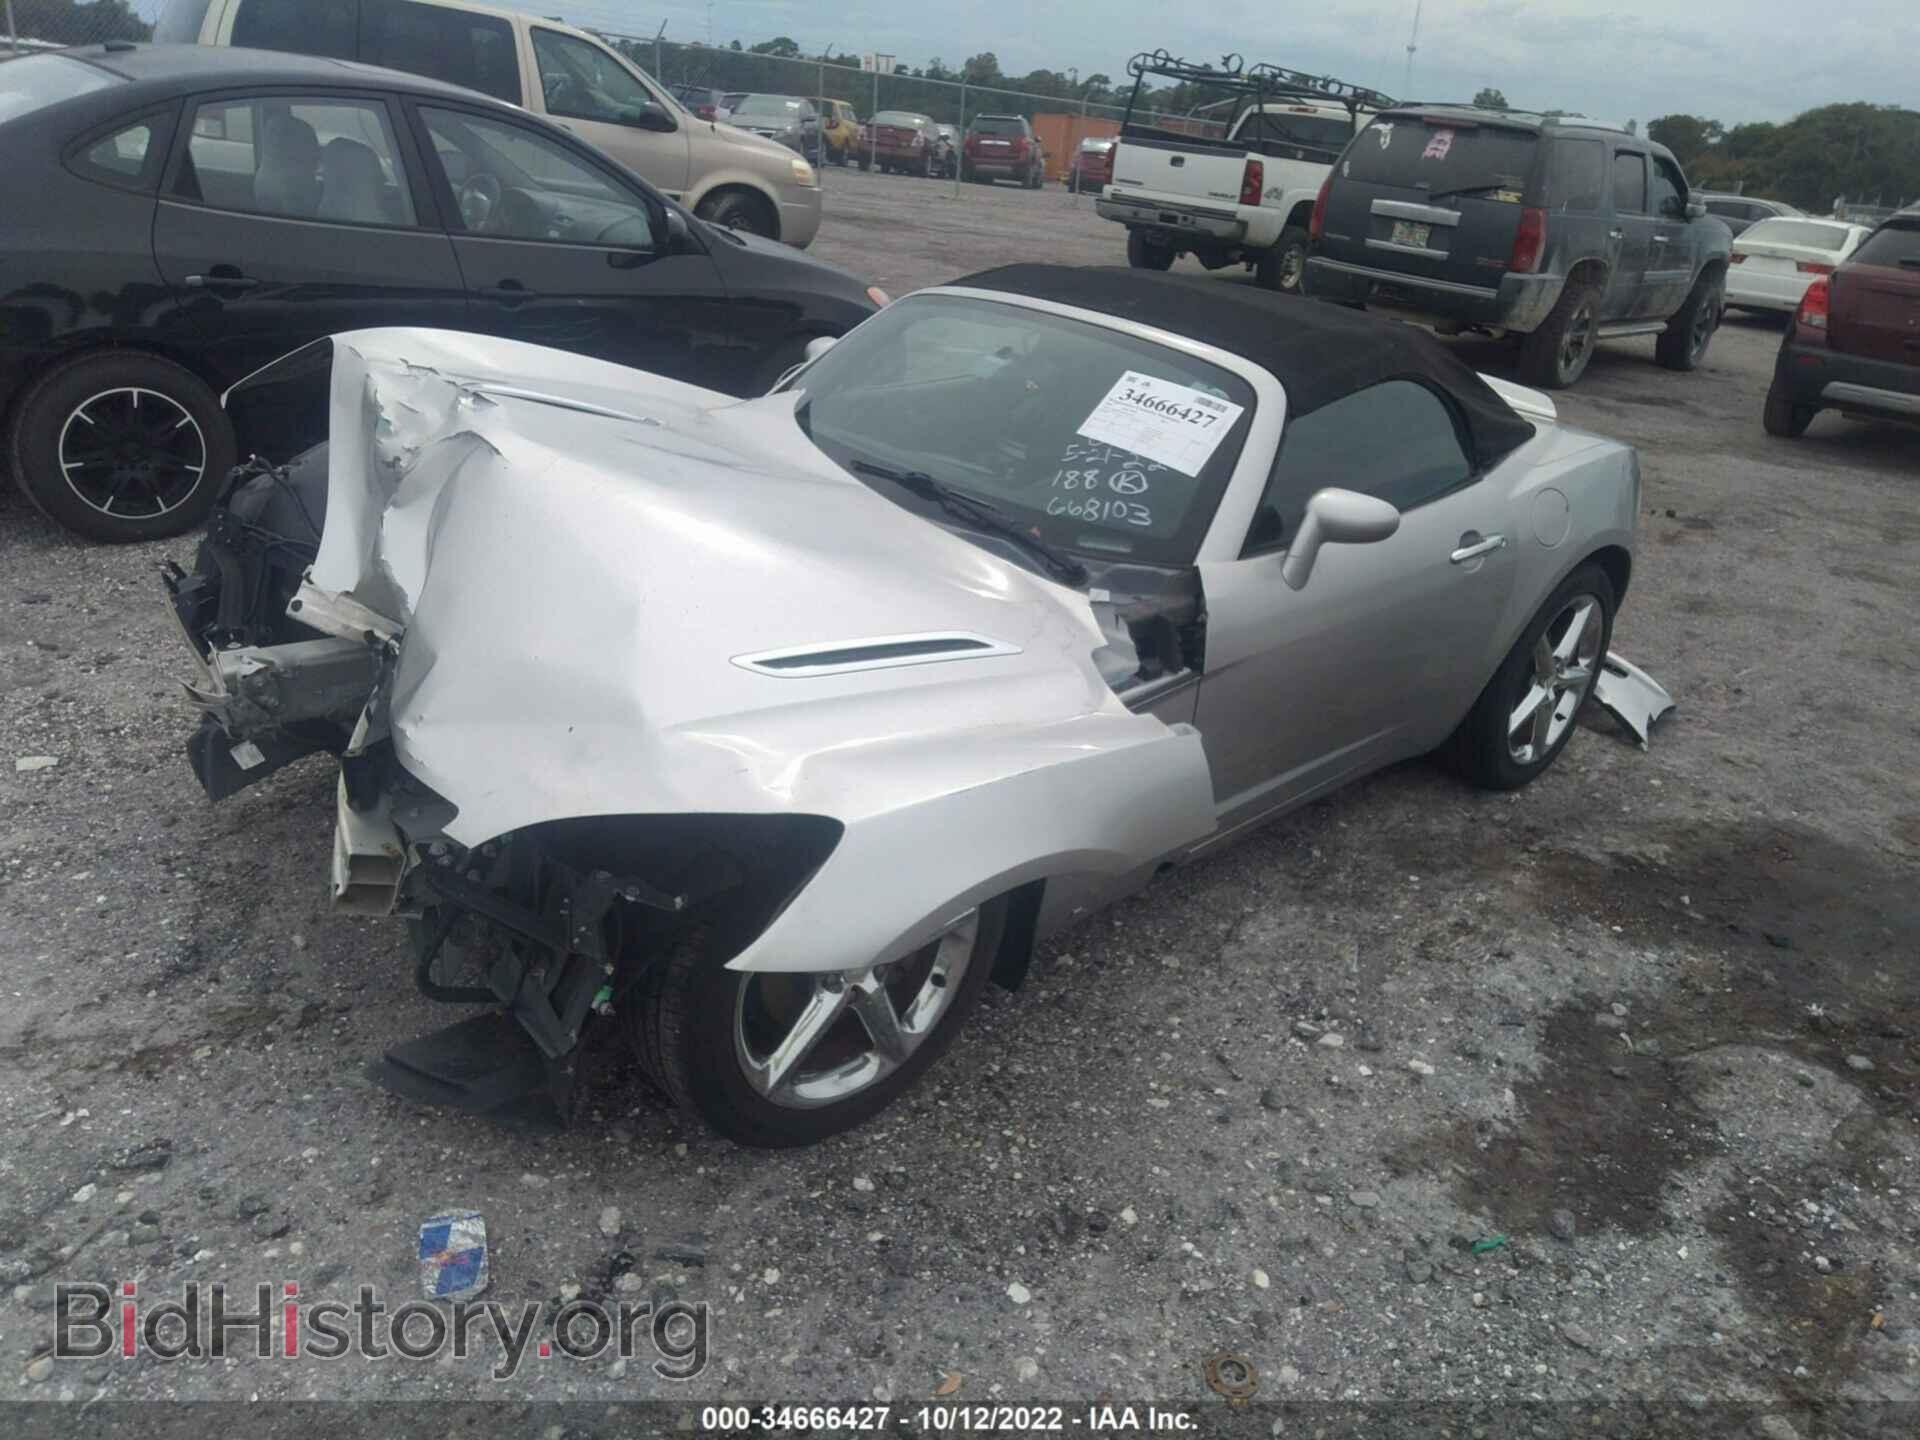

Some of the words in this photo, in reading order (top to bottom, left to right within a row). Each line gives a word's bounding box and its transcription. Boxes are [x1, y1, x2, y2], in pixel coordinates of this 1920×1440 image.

[1118, 388, 1217, 428] 34666427
[1051, 469, 1100, 490] 188
[1046, 497, 1153, 526] 668103
